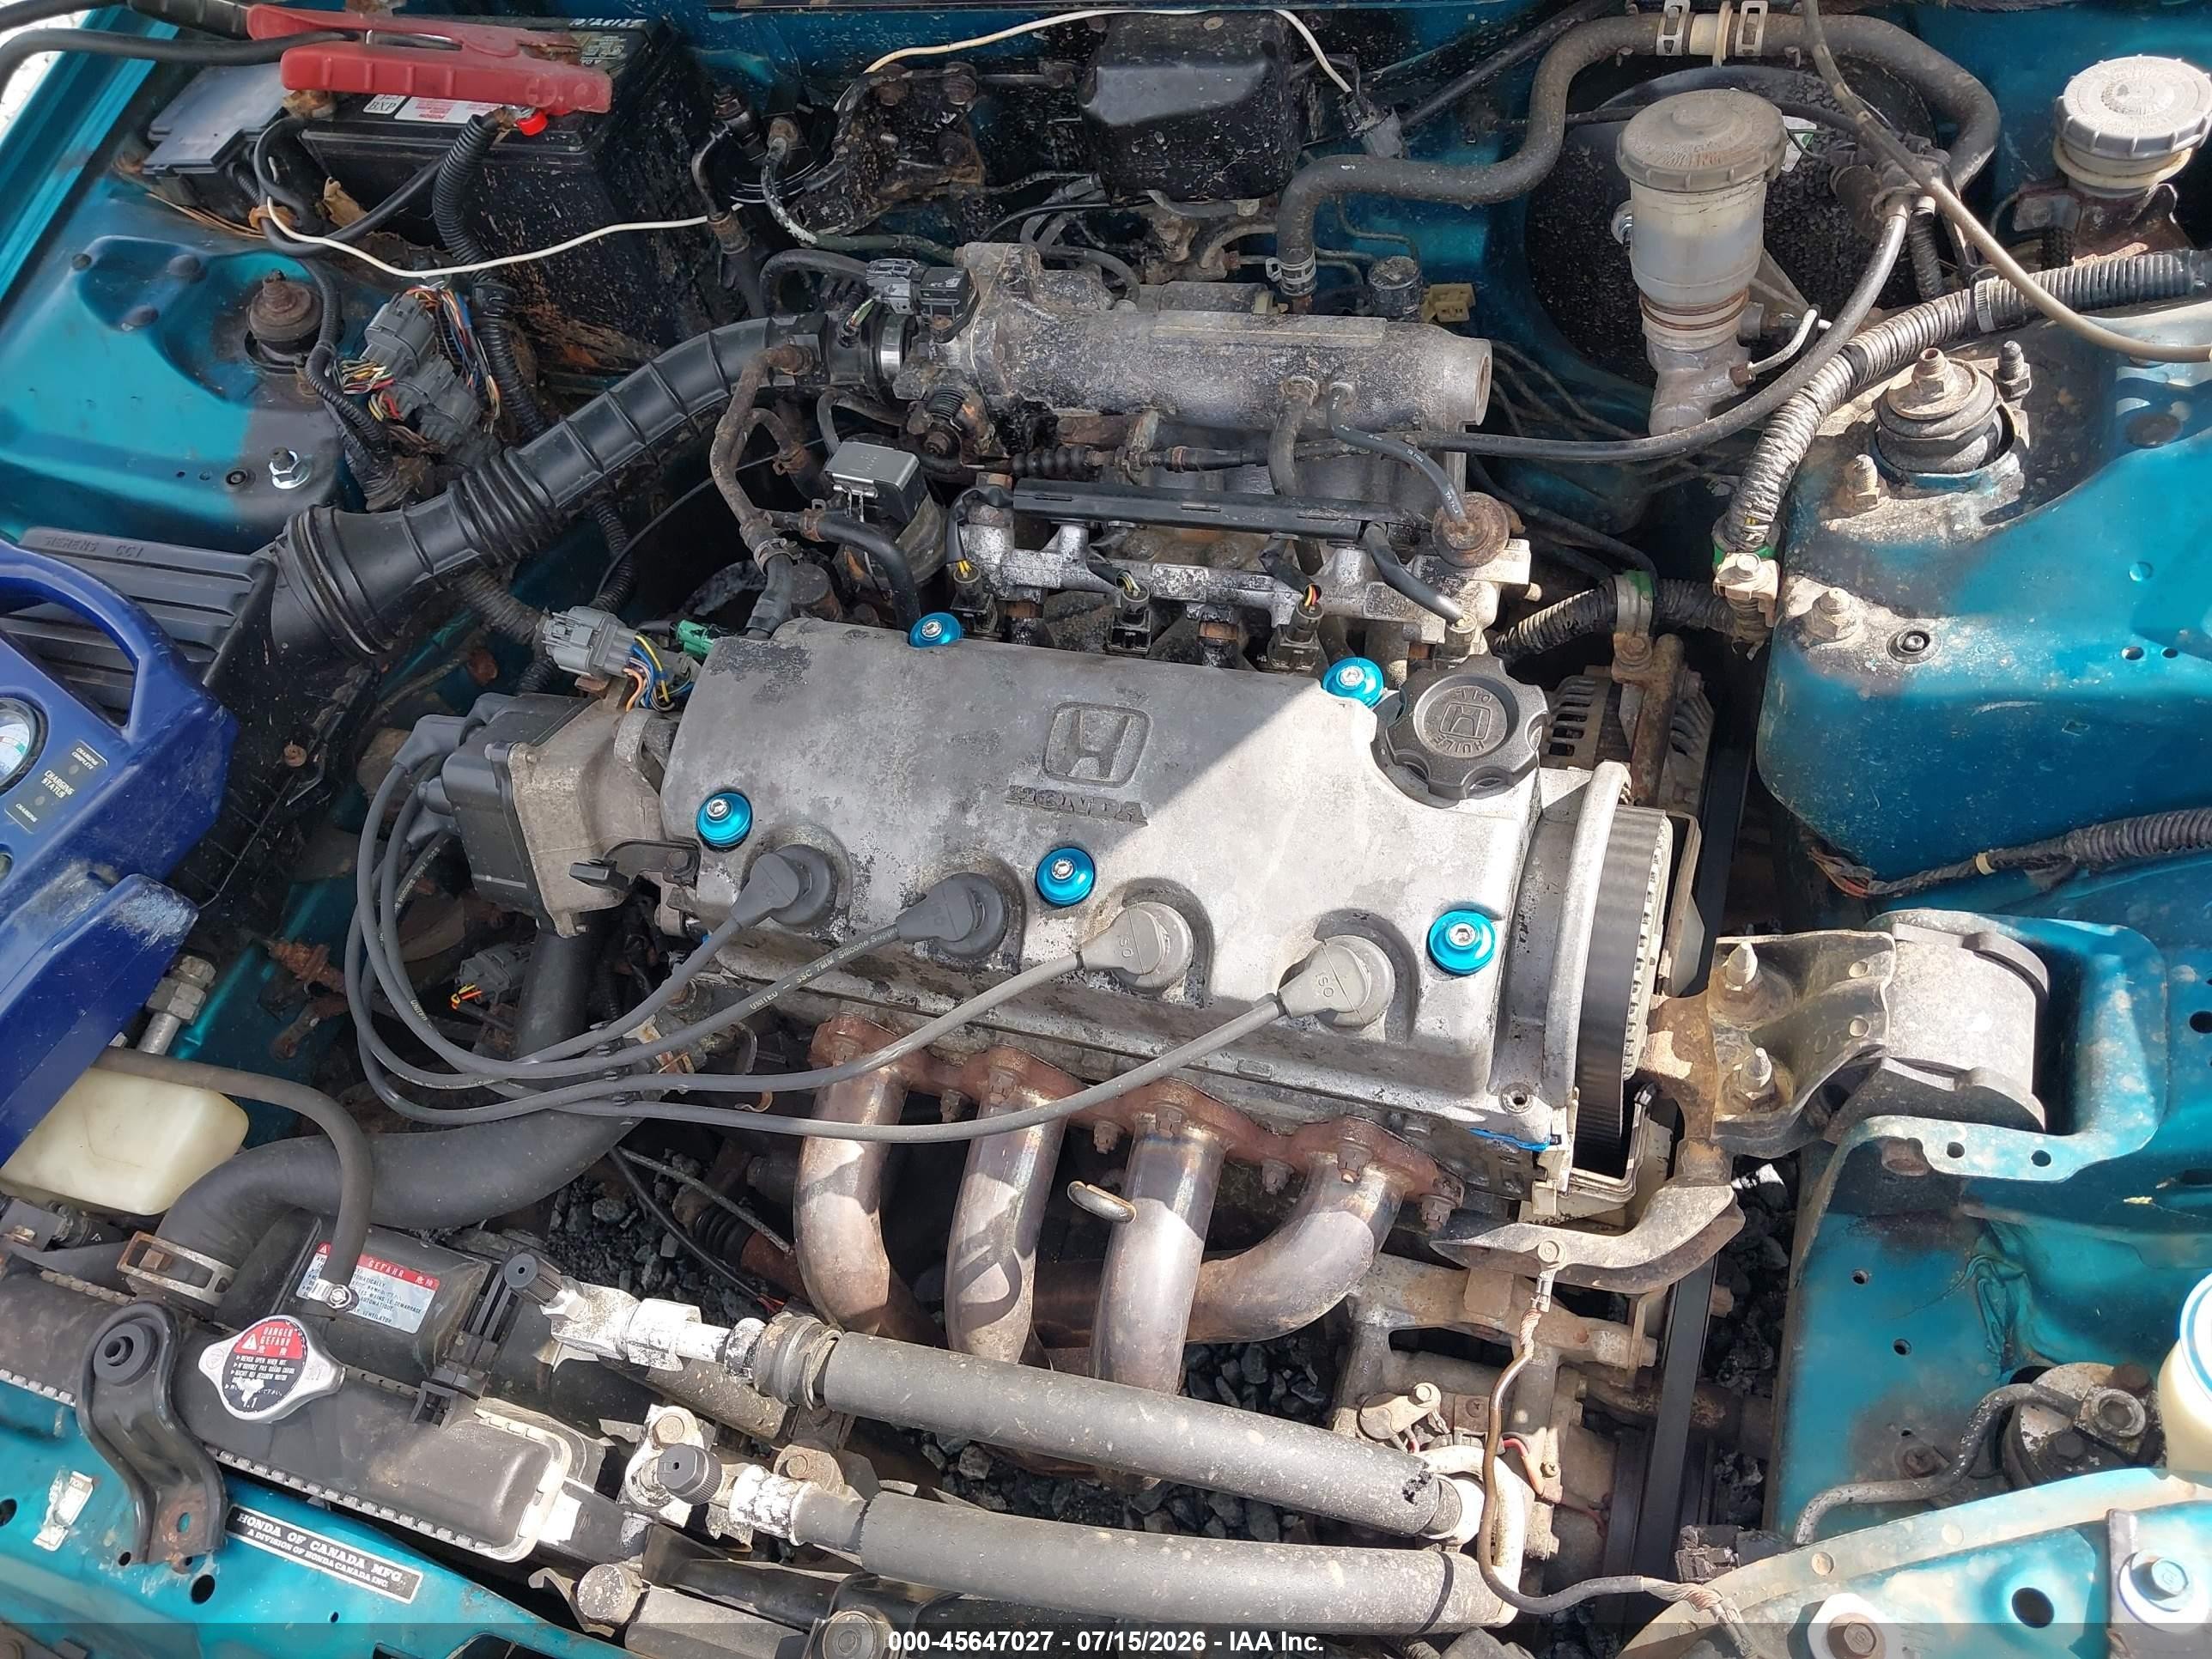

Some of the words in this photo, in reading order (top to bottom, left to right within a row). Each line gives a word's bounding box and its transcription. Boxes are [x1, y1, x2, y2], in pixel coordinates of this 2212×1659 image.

[1454, 689, 1492, 702] OIL
[1433, 734, 1486, 754] HUILE
[41, 777, 66, 799] STATUS
[44, 769, 75, 796] CHARGING
[1006, 784, 1149, 826] HONDA
[368, 1260, 404, 1278] GEFAHR
[259, 1335, 291, 1347] GEFAHR
[263, 1327, 294, 1338] DANGER
[237, 1512, 282, 1539] HONDA
[286, 1530, 307, 1546] OF
[309, 1540, 366, 1570] CANADA
[255, 1532, 294, 1552] DIVISION
[292, 1547, 306, 1555] OF
[305, 1551, 335, 1568] HONDA
[334, 1562, 372, 1583] CANADA
